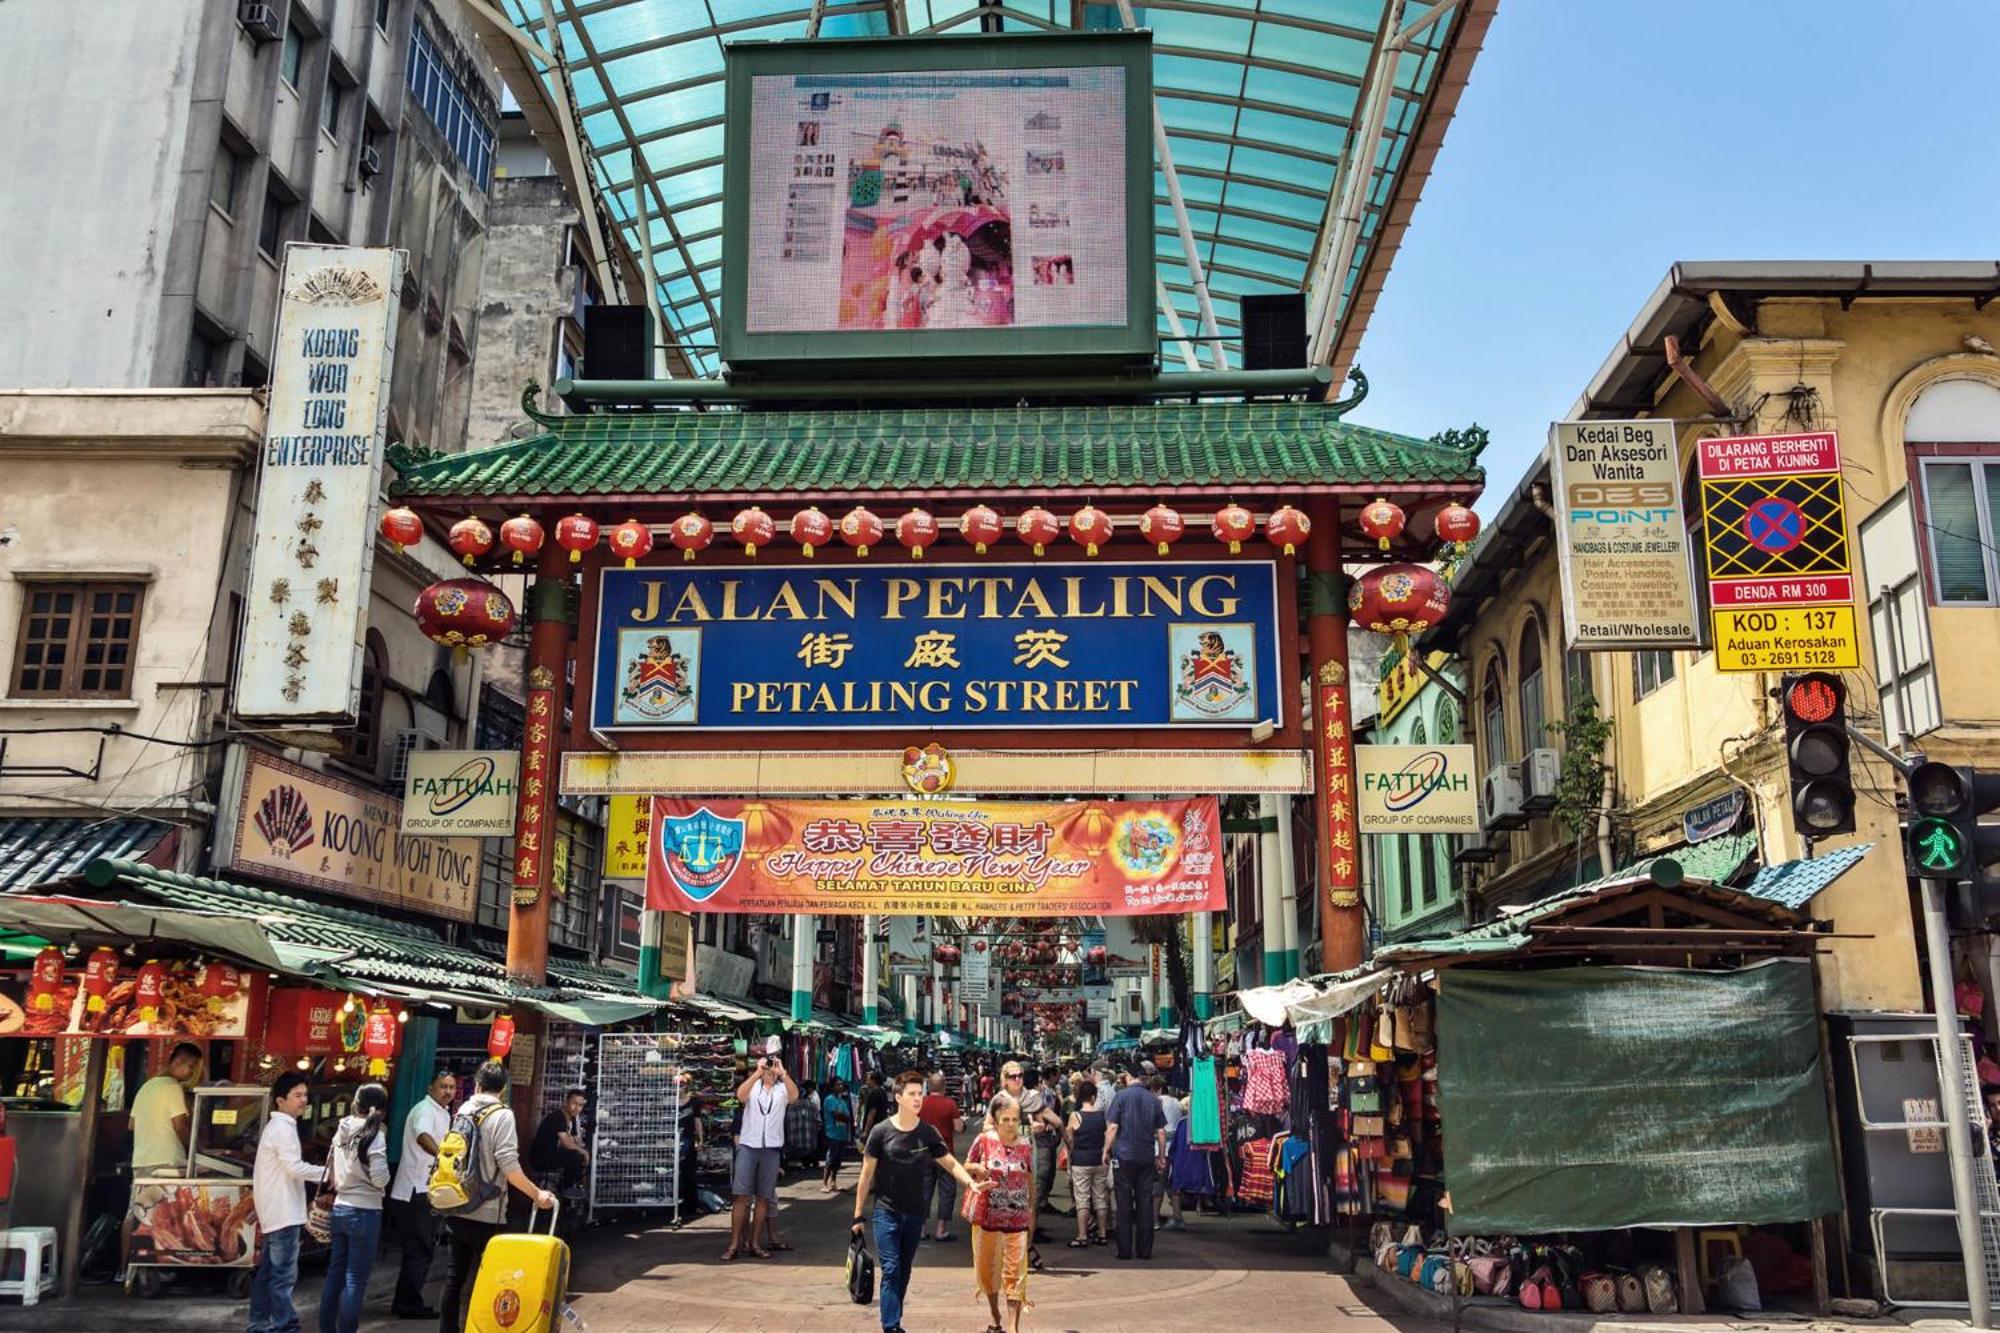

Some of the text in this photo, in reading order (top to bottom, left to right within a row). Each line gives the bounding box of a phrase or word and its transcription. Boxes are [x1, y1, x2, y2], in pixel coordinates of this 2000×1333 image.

[303, 328, 360, 358] KOONG
[1576, 426, 1653, 446] Kedai Beg
[267, 435, 371, 466] ENTERPRISE
[1567, 444, 1668, 462] Dan Aksesori
[1708, 438, 1828, 458] DILARANG BERHENTI
[1719, 453, 1819, 471] DI PETAK KUNING
[1592, 463, 1645, 480] Wanita
[1576, 487, 1669, 504] DES
[1573, 543, 1607, 554] HANDBAGS
[1613, 542, 1643, 553] COSTUME
[1644, 541, 1680, 553] JEWELLERY
[1583, 559, 1604, 568] Hair
[1580, 580, 1627, 590] Costume
[1735, 583, 1827, 600] DENDA RM 300
[631, 575, 1242, 622] JALAN PETALING
[1580, 623, 1691, 637] Retail/Wholesale
[1733, 613, 1777, 632] KOD
[1803, 611, 1837, 630] 137
[1727, 636, 1846, 651] Aduan Kerosakan
[1741, 652, 1757, 666] 03
[1770, 651, 1799, 665] 2691
[1804, 651, 1836, 665] 5128
[730, 680, 1138, 713] PETALING STREET
[412, 778, 511, 796] FATTUAH
[1364, 773, 1469, 791] FATTUAH
[407, 819, 511, 828] GROUP OF COMPANIES
[1363, 815, 1474, 825] GROUP OF COMPANIES
[802, 819, 1056, 854] 恭喜發財
[322, 810, 387, 863] KOONG
[392, 833, 432, 876] WOH
[436, 847, 472, 886] TONG
[767, 851, 864, 883] Happy
[868, 851, 960, 877] Chinese
[964, 852, 1020, 877] New
[1020, 851, 1091, 886] Year
[816, 880, 1036, 893] SELAMAT TAHUN BARU CINA
[1070, 902, 1112, 910] ASSOCIATION
